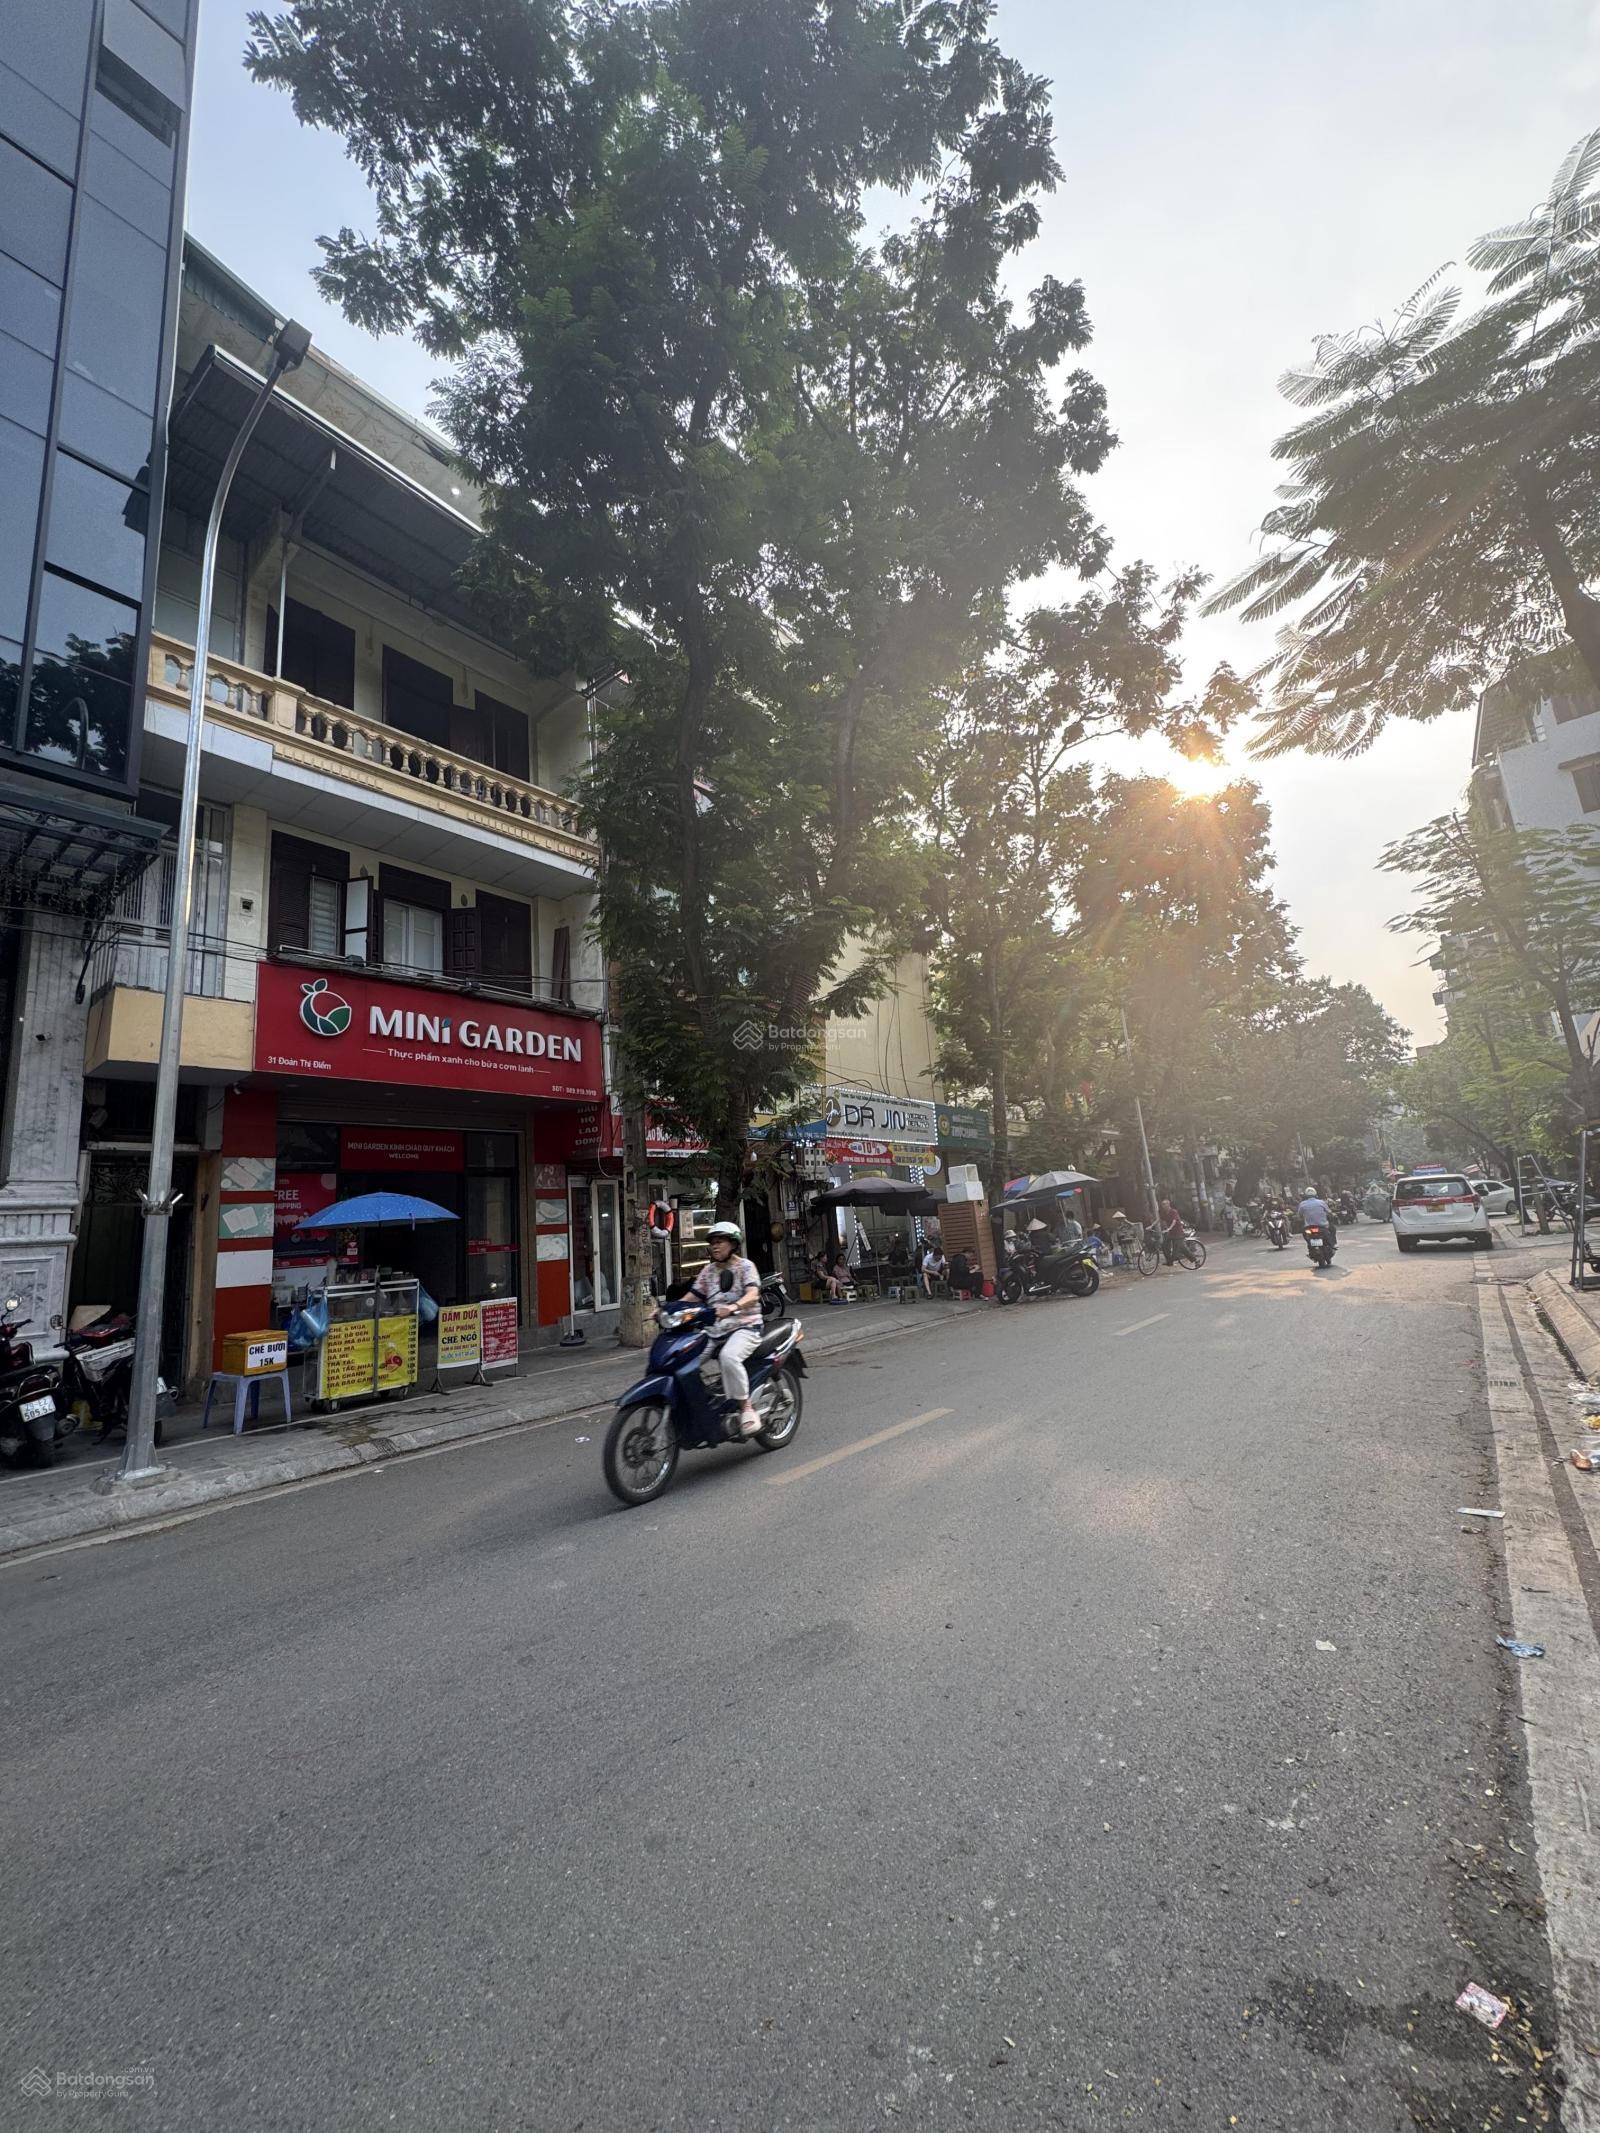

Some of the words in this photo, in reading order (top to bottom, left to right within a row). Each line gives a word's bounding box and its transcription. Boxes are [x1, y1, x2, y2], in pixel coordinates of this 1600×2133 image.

[458, 1020, 582, 1062] GARDEN
[267, 1055, 277, 1064] 31
[278, 1056, 298, 1067] Đoàn
[300, 1058, 312, 1070] Thị
[387, 1048, 413, 1061] Thực
[442, 1055, 463, 1065] xanh
[464, 1057, 480, 1067] cho
[498, 1062, 517, 1071] cơm
[844, 1104, 875, 1128] DR
[880, 1109, 906, 1131] JIN
[578, 1126, 599, 1135] LAO
[274, 1202, 302, 1210] HIPPING
[259, 1357, 275, 1367] 15K
